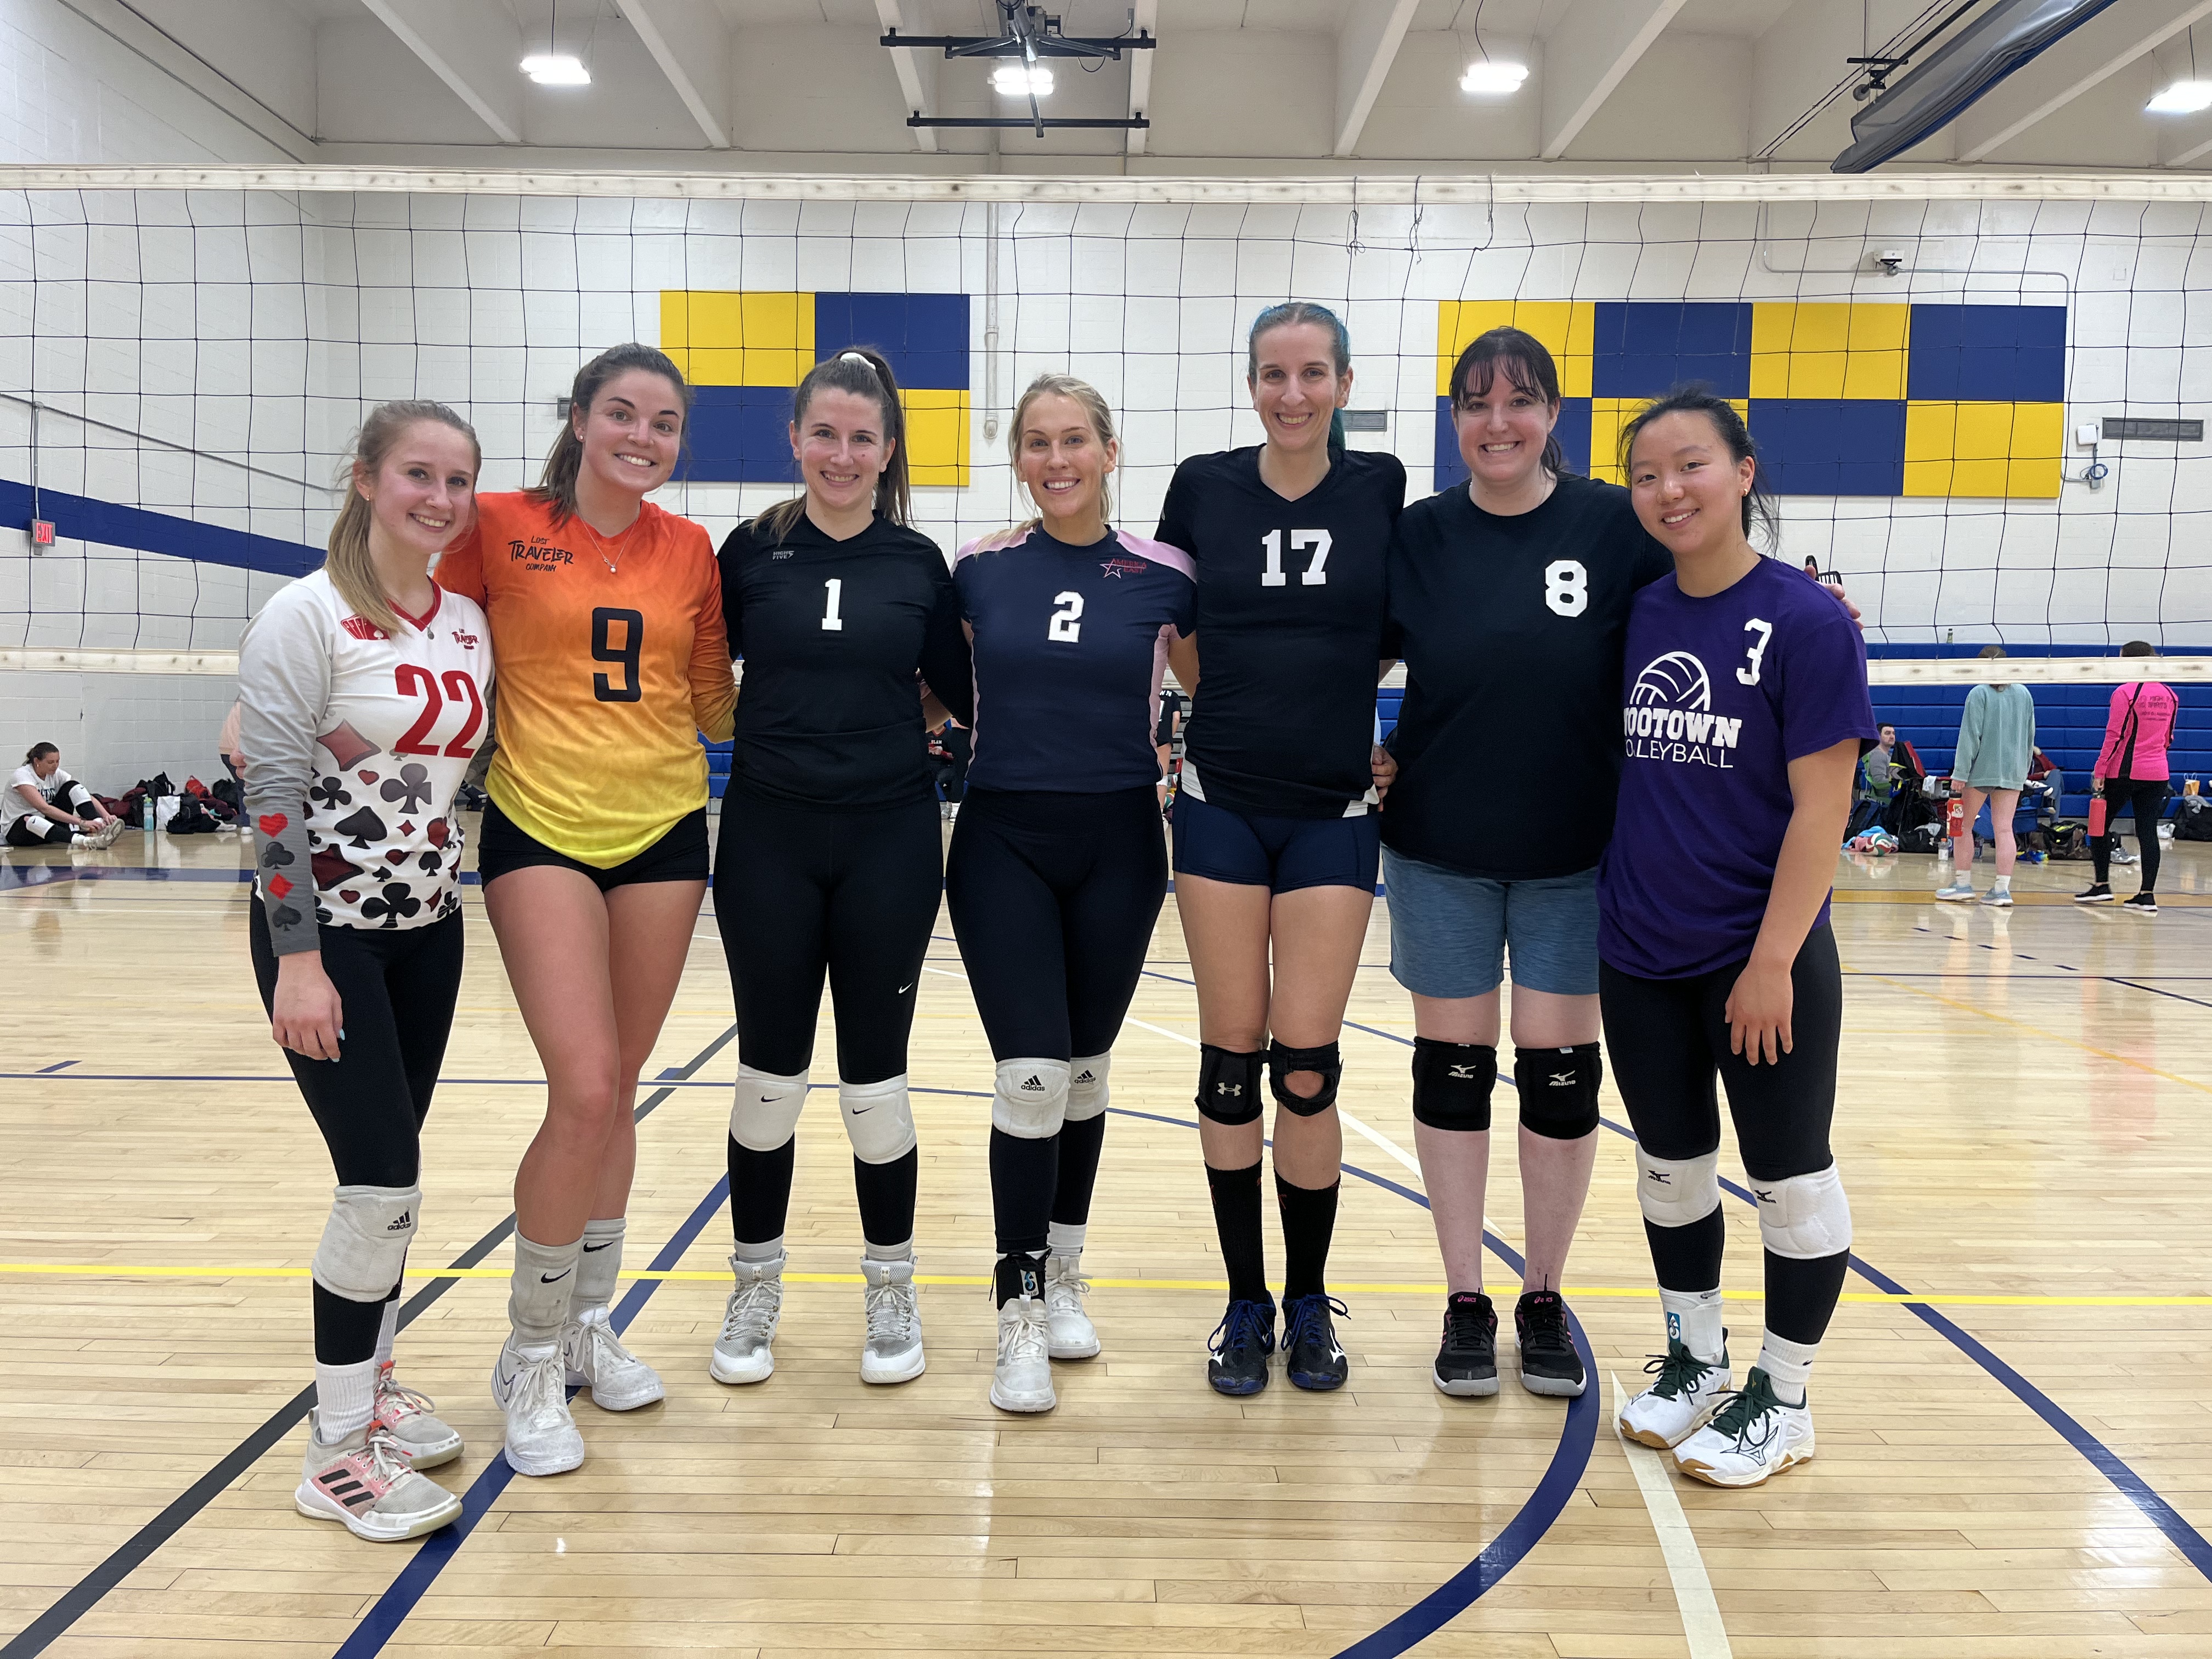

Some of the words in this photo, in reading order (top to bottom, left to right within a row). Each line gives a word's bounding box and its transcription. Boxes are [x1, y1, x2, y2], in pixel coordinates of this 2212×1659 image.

[36, 522, 53, 543] EXIT
[508, 540, 574, 565] TRAVELER
[531, 535, 550, 544] LOST
[1262, 529, 1333, 586] 17
[526, 563, 556, 572] COMPANY
[1544, 559, 1588, 618] 8
[822, 578, 842, 631] 1
[1047, 590, 1085, 643] 2
[592, 607, 643, 702] 9
[1736, 618, 1773, 686] 3
[394, 664, 483, 759] 22
[1625, 738, 1734, 768] OLEYBALL
[1074, 1076, 1096, 1084] adidas
